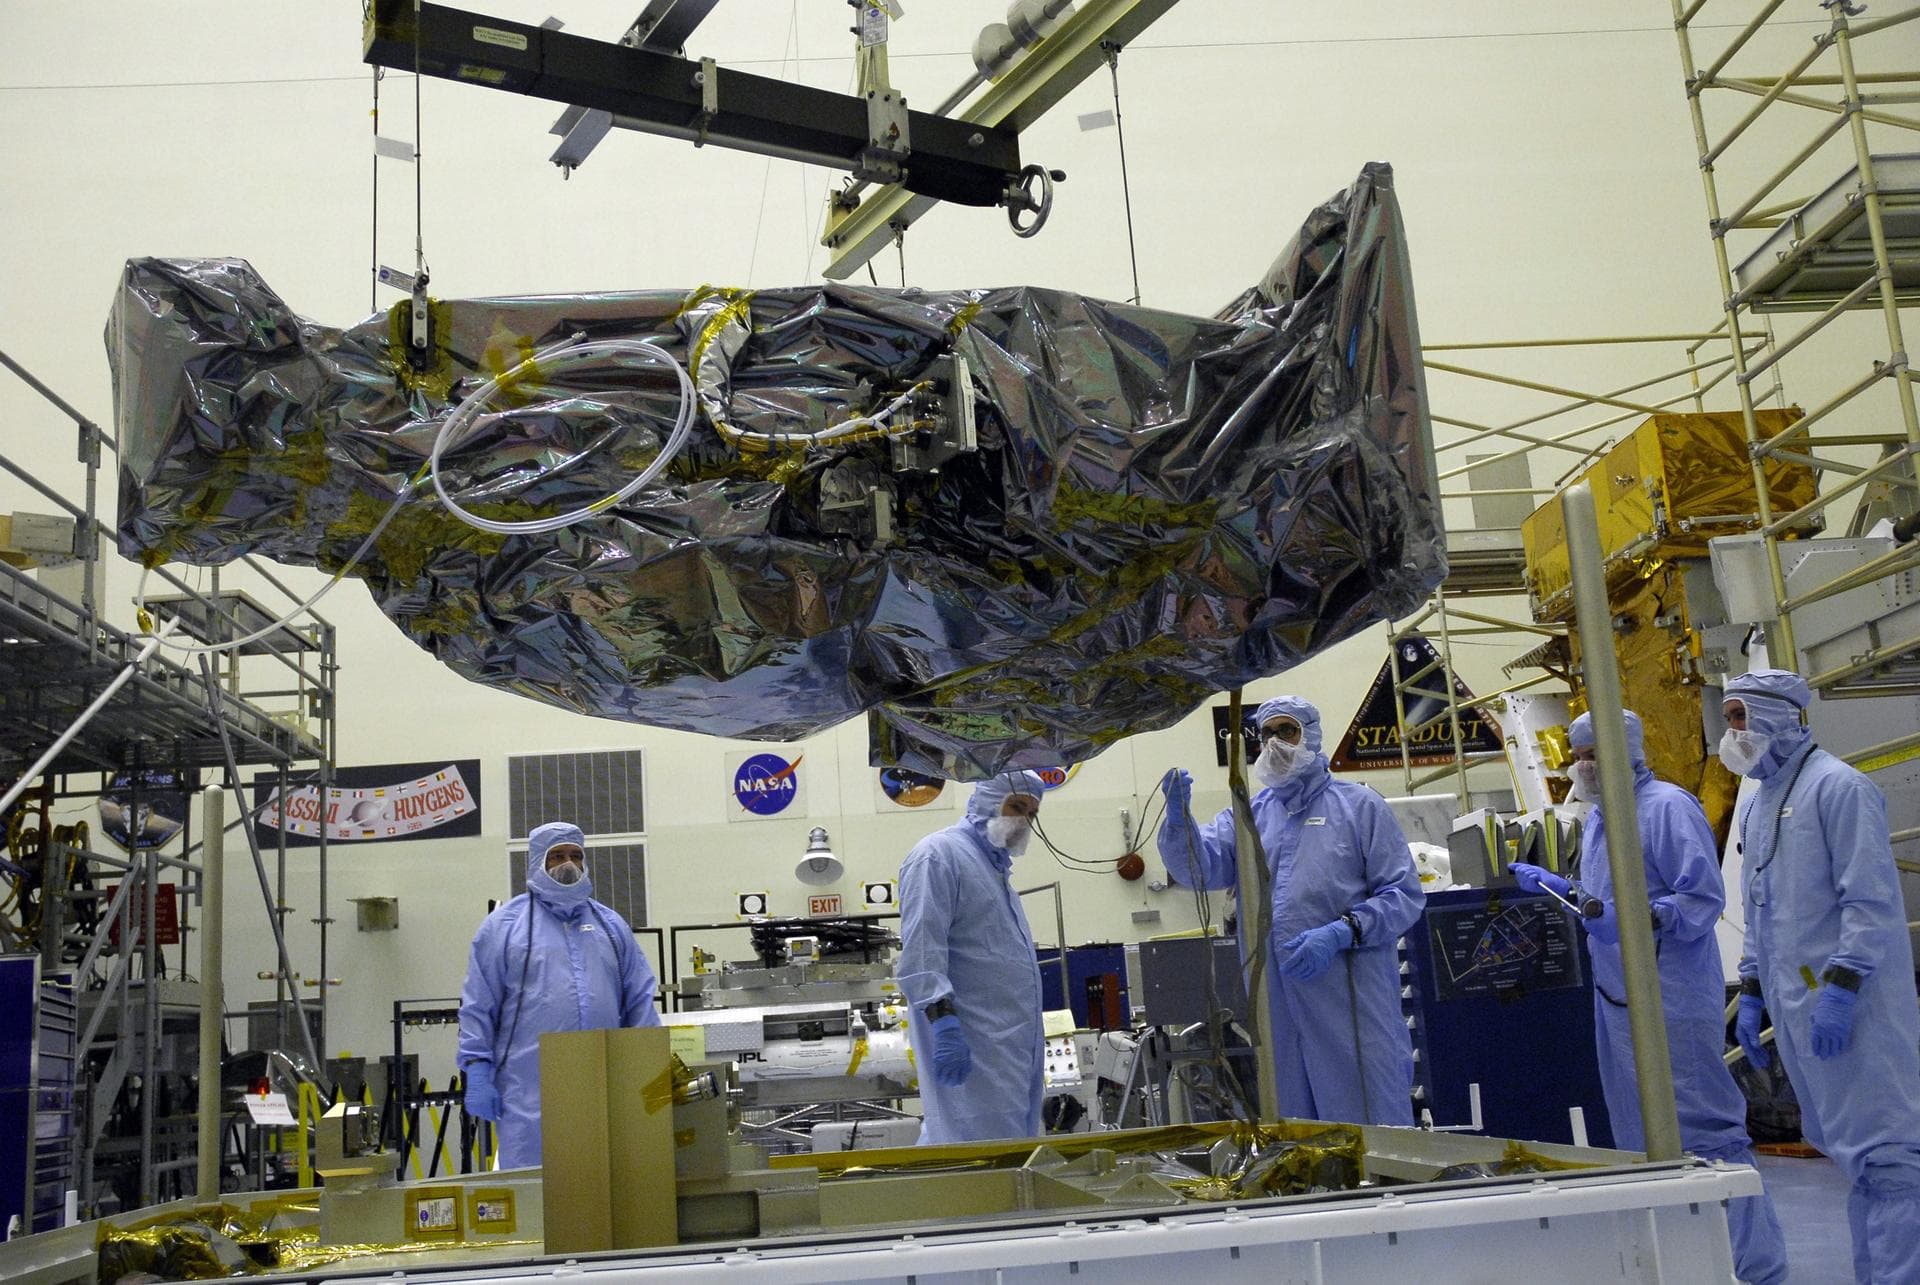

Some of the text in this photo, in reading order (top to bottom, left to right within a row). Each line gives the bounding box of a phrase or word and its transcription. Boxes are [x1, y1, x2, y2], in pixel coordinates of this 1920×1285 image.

[1359, 759, 1415, 769] UNIVERSIY
[739, 776, 793, 792] NASA
[394, 780, 465, 822] HUYGENS
[811, 898, 839, 913] EXIT
[736, 1051, 768, 1064] JPL
